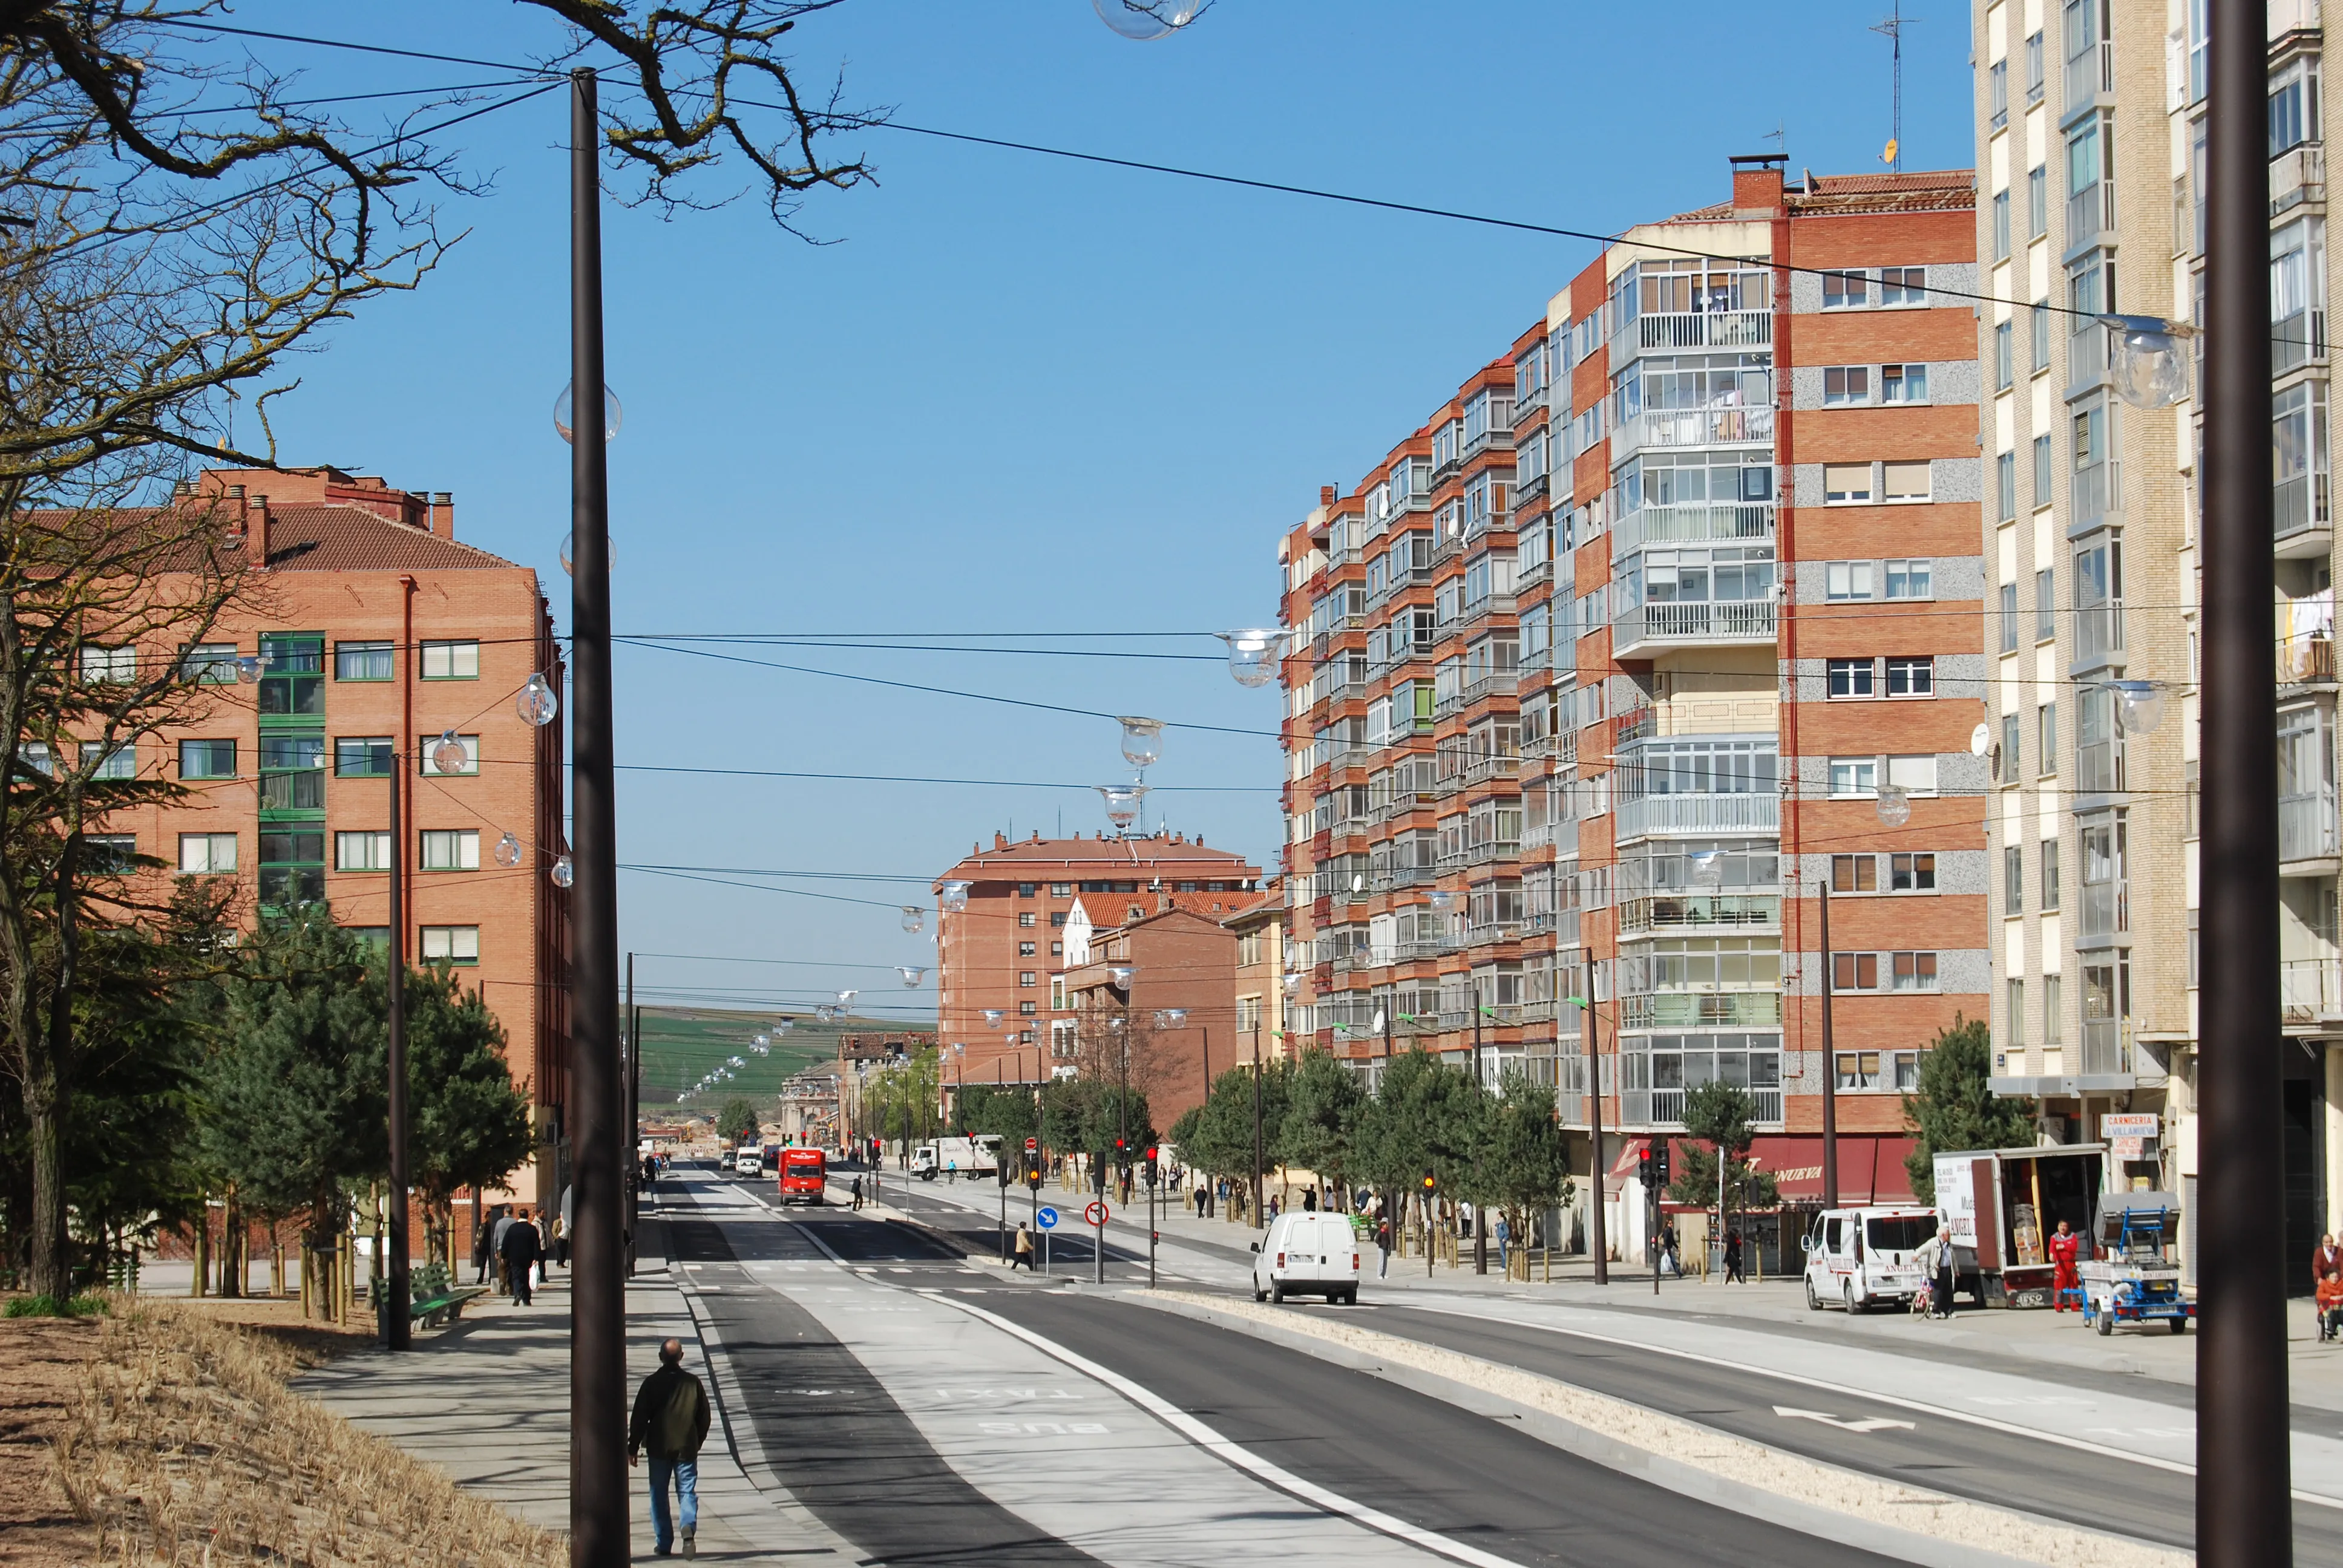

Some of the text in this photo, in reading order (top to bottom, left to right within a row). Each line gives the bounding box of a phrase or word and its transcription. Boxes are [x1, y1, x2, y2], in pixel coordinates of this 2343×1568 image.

[2108, 1116, 2152, 1125] CARNICERIA
[2112, 1126, 2155, 1135] VILLANUEVA
[1950, 1218, 1971, 1236] ANGEL
[1885, 1264, 1915, 1273] ANGEL
[977, 1422, 1112, 1434] BUS
